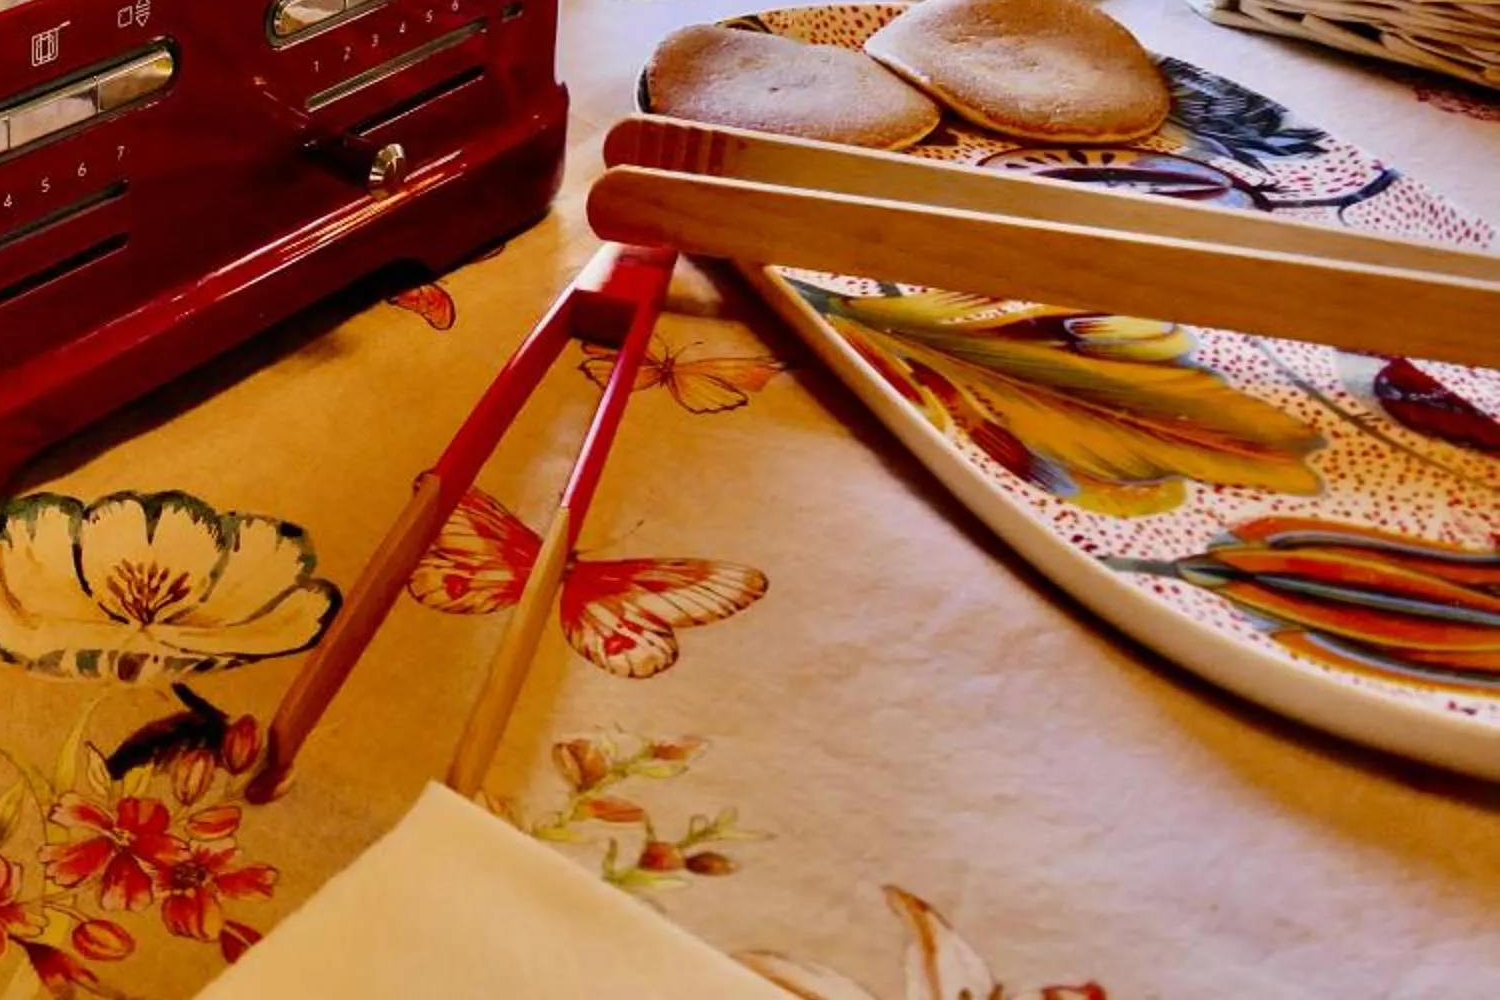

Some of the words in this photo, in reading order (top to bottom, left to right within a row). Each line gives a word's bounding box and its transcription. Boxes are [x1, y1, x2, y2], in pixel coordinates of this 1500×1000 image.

[313, 60, 319, 73] 1
[371, 33, 379, 48] 3
[425, 9, 433, 23] 5
[41, 177, 51, 193] 5
[77, 162, 87, 177] 6
[117, 145, 125, 160] 7
